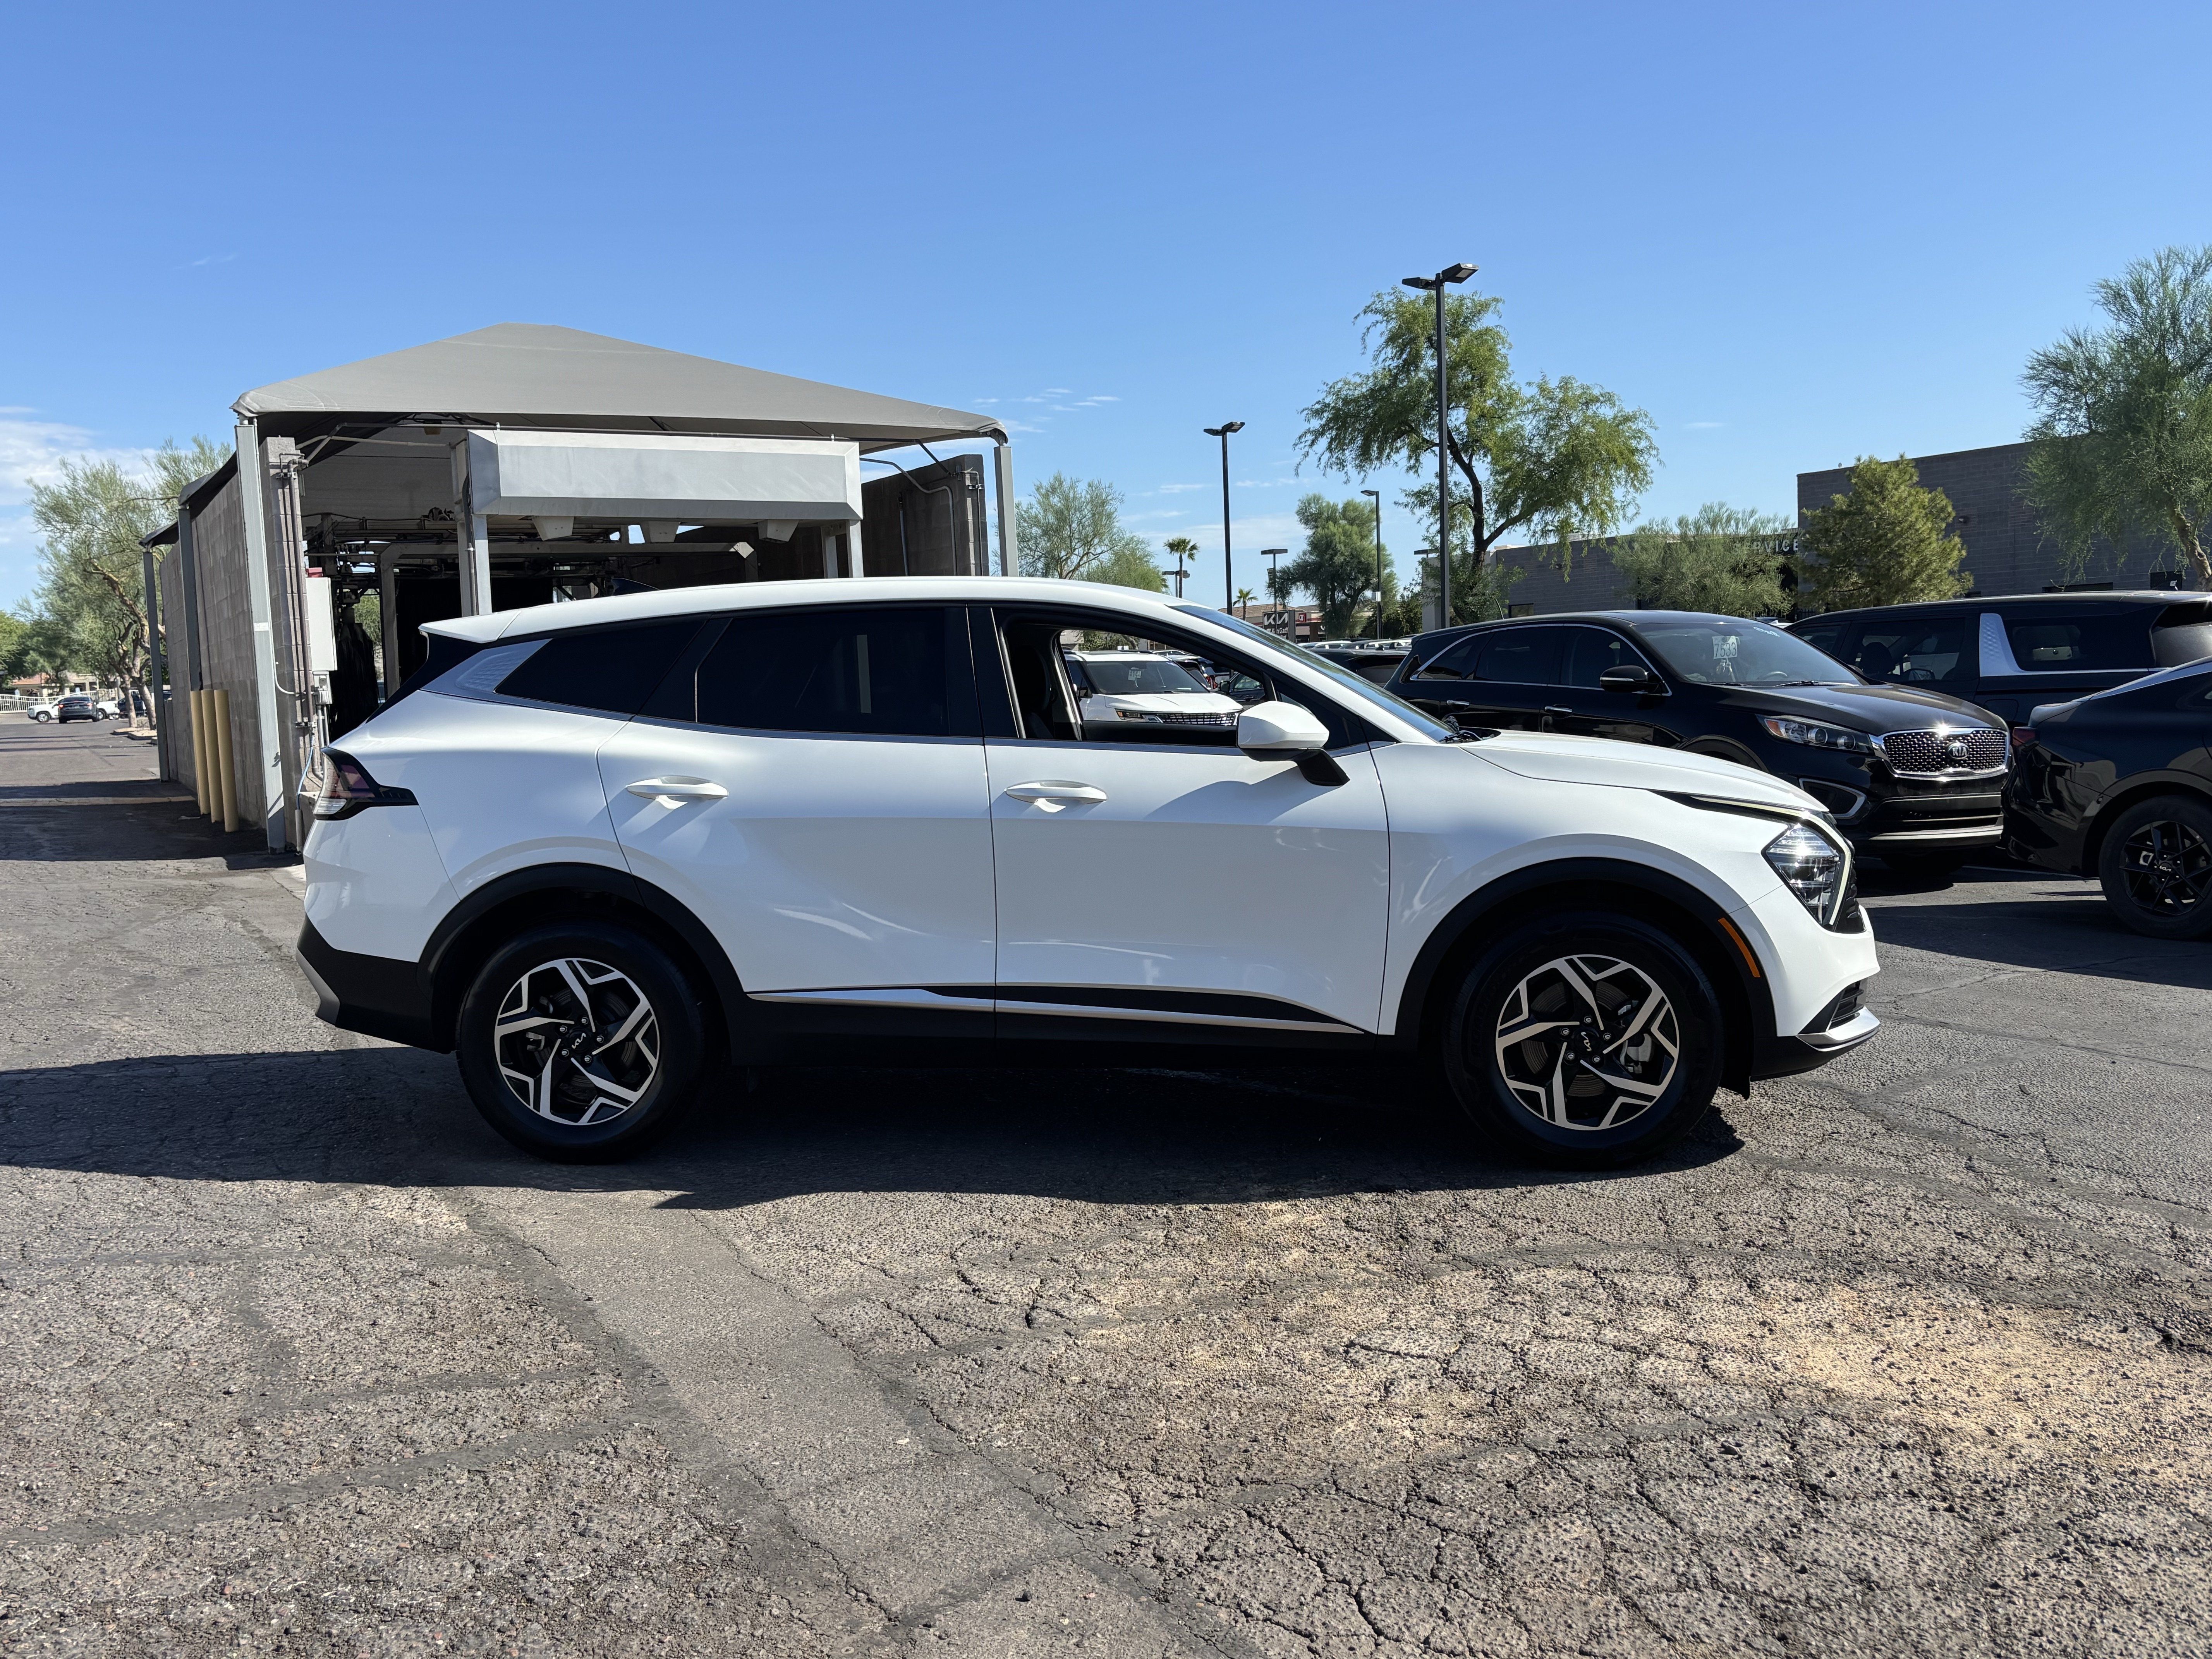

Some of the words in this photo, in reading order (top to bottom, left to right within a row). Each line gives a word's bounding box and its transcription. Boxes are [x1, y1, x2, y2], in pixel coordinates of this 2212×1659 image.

[1264, 613, 1288, 625] KIA
[1714, 642, 1736, 658] 7533
[1953, 747, 1966, 756] KIA
[572, 1033, 586, 1049] KIA
